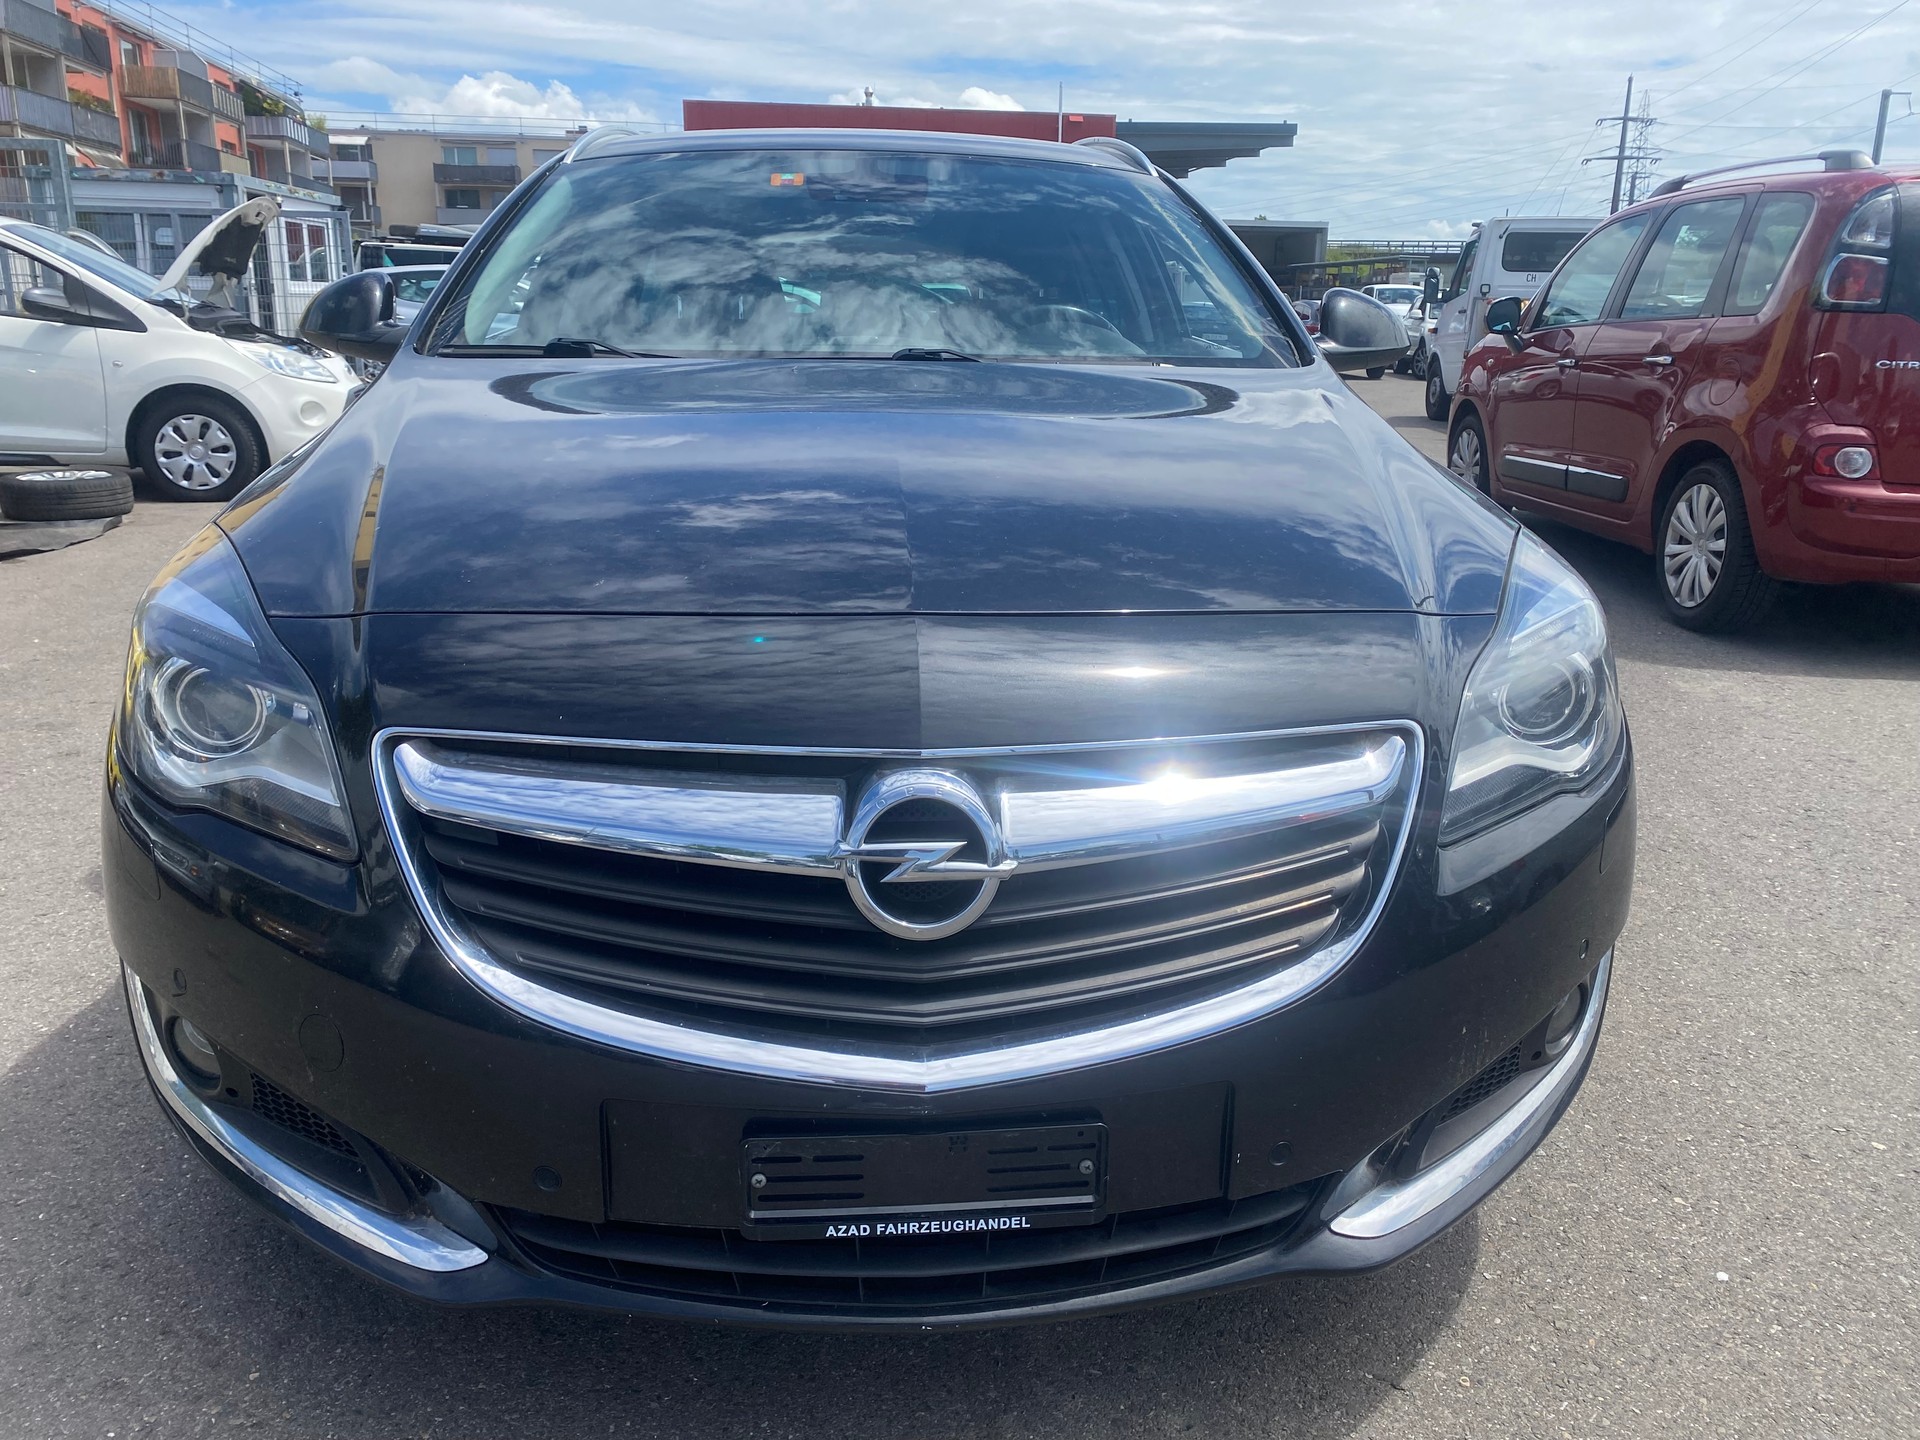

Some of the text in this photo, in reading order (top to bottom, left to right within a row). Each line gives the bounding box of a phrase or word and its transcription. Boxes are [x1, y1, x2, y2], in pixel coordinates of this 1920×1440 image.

[1526, 273, 1537, 283] CH
[875, 787, 970, 809] OPEL
[825, 1216, 1031, 1237] AZAD FAHRZEUGHANDEL
